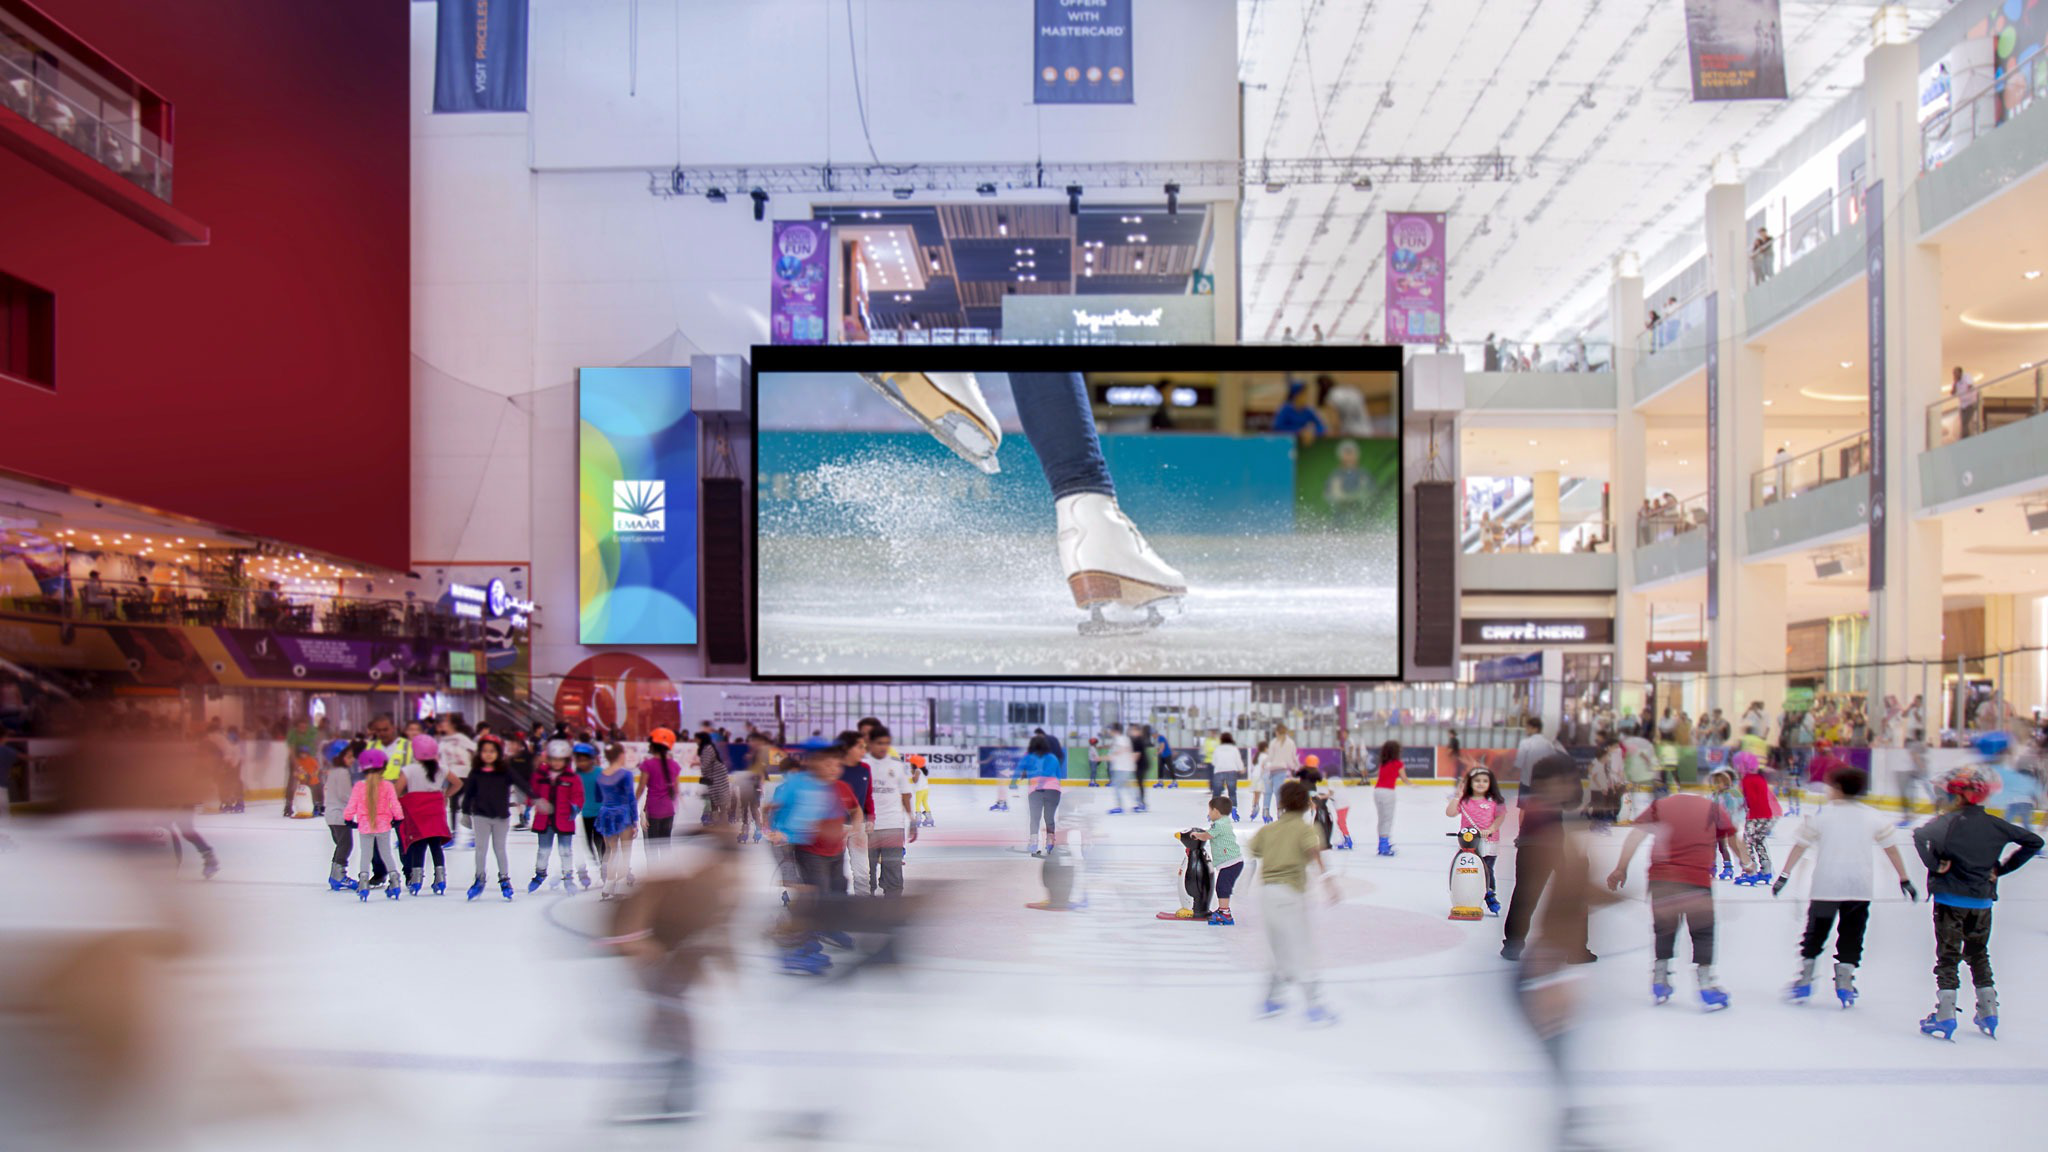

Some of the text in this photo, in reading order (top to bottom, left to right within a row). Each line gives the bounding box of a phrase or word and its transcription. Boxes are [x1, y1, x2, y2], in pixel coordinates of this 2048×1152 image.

[1067, 12, 1100, 22] WITH
[1041, 26, 1124, 37] MASTERCARD
[475, 62, 486, 93] VISIT
[1399, 237, 1427, 248] FUN
[785, 244, 811, 255] FUN
[1072, 308, 1162, 334] Yogurtland
[617, 519, 660, 529] EMAAR
[1537, 625, 1584, 640] NERO
[1460, 856, 1475, 866] 54
